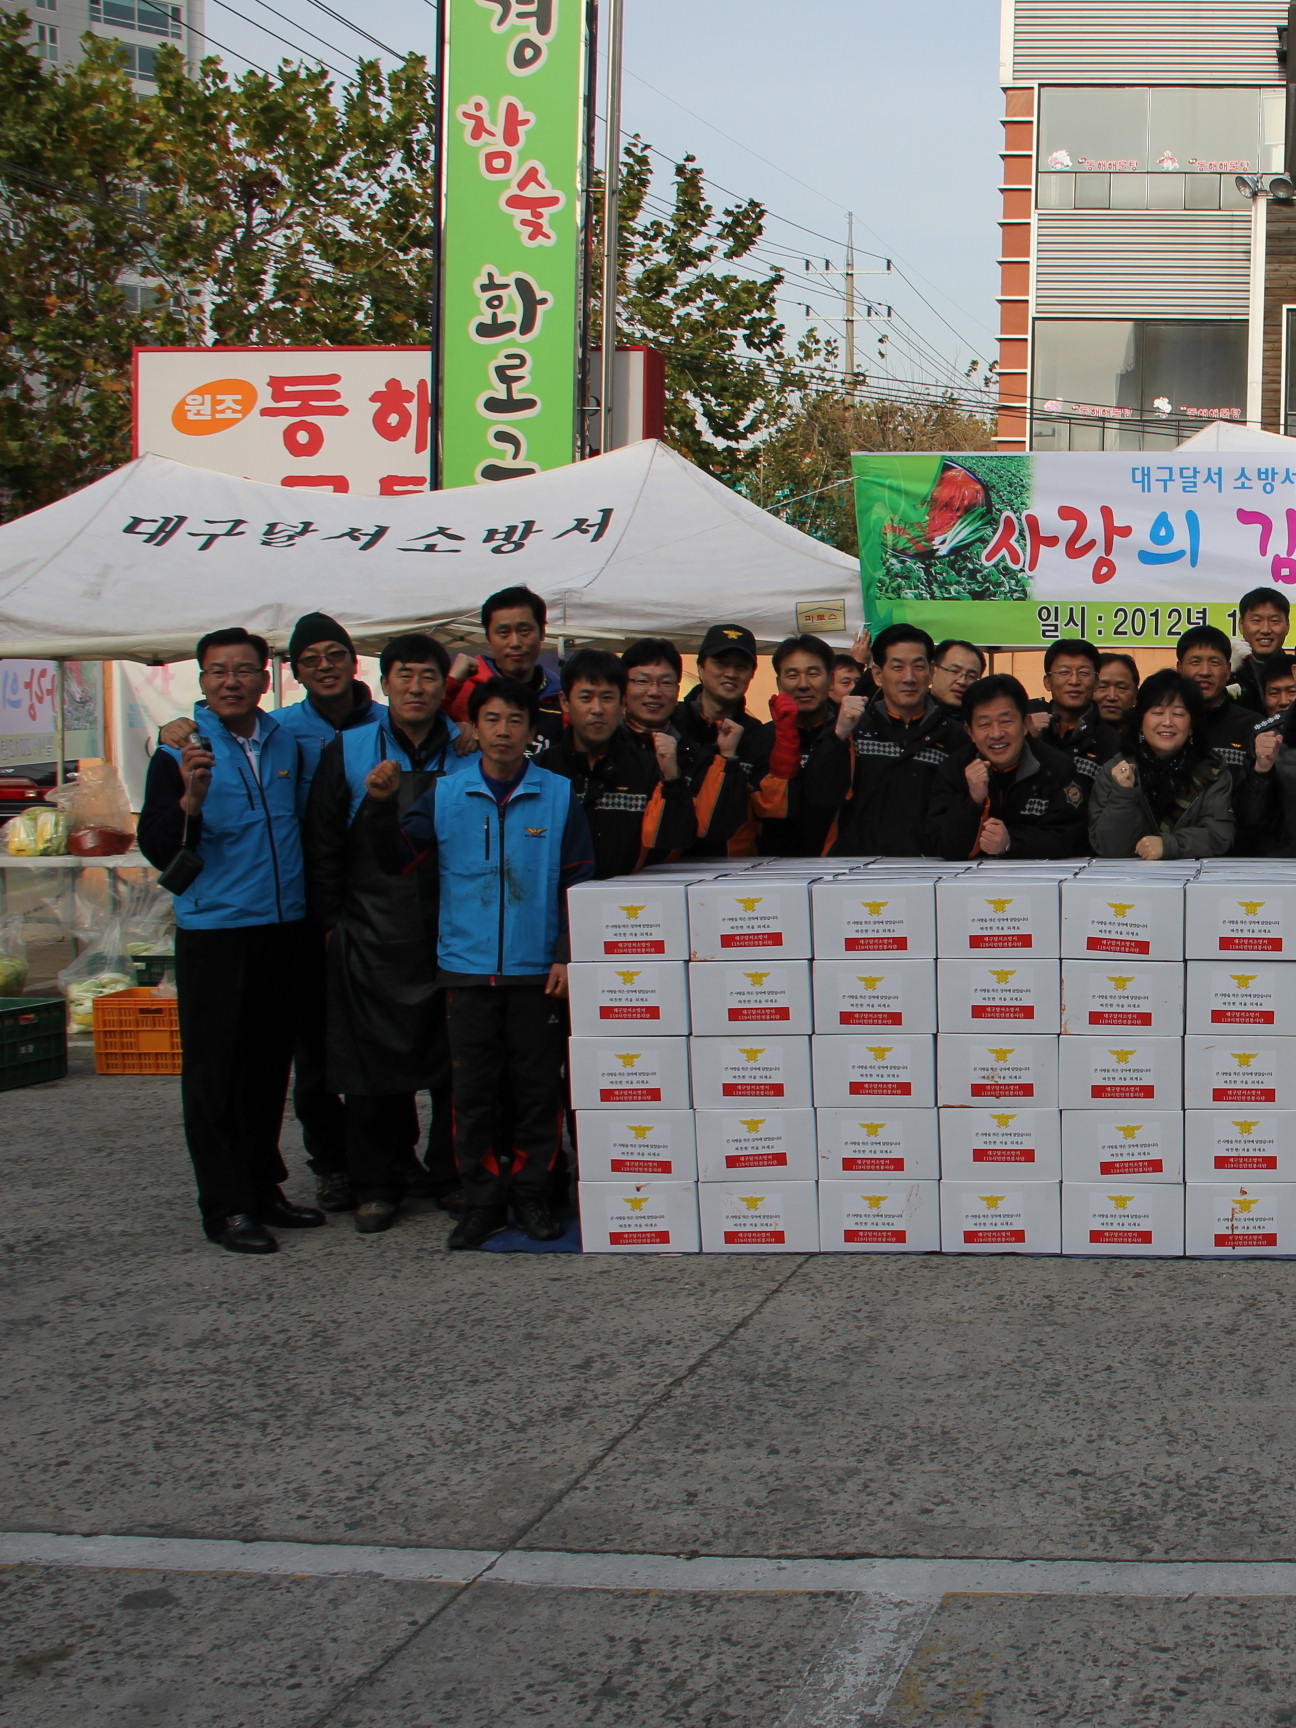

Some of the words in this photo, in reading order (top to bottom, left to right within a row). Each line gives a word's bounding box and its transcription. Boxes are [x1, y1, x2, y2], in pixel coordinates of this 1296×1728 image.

[460, 100, 561, 242] 참숯
[1085, 160, 1138, 171] 동해해물탕
[1197, 160, 1250, 171] 동해해물탕
[184, 394, 243, 420] 원조
[1131, 464, 1224, 494] 대구달서
[984, 504, 1201, 585] 사랑의
[804, 613, 838, 623] 파로스
[1112, 606, 1209, 638] 2012년
